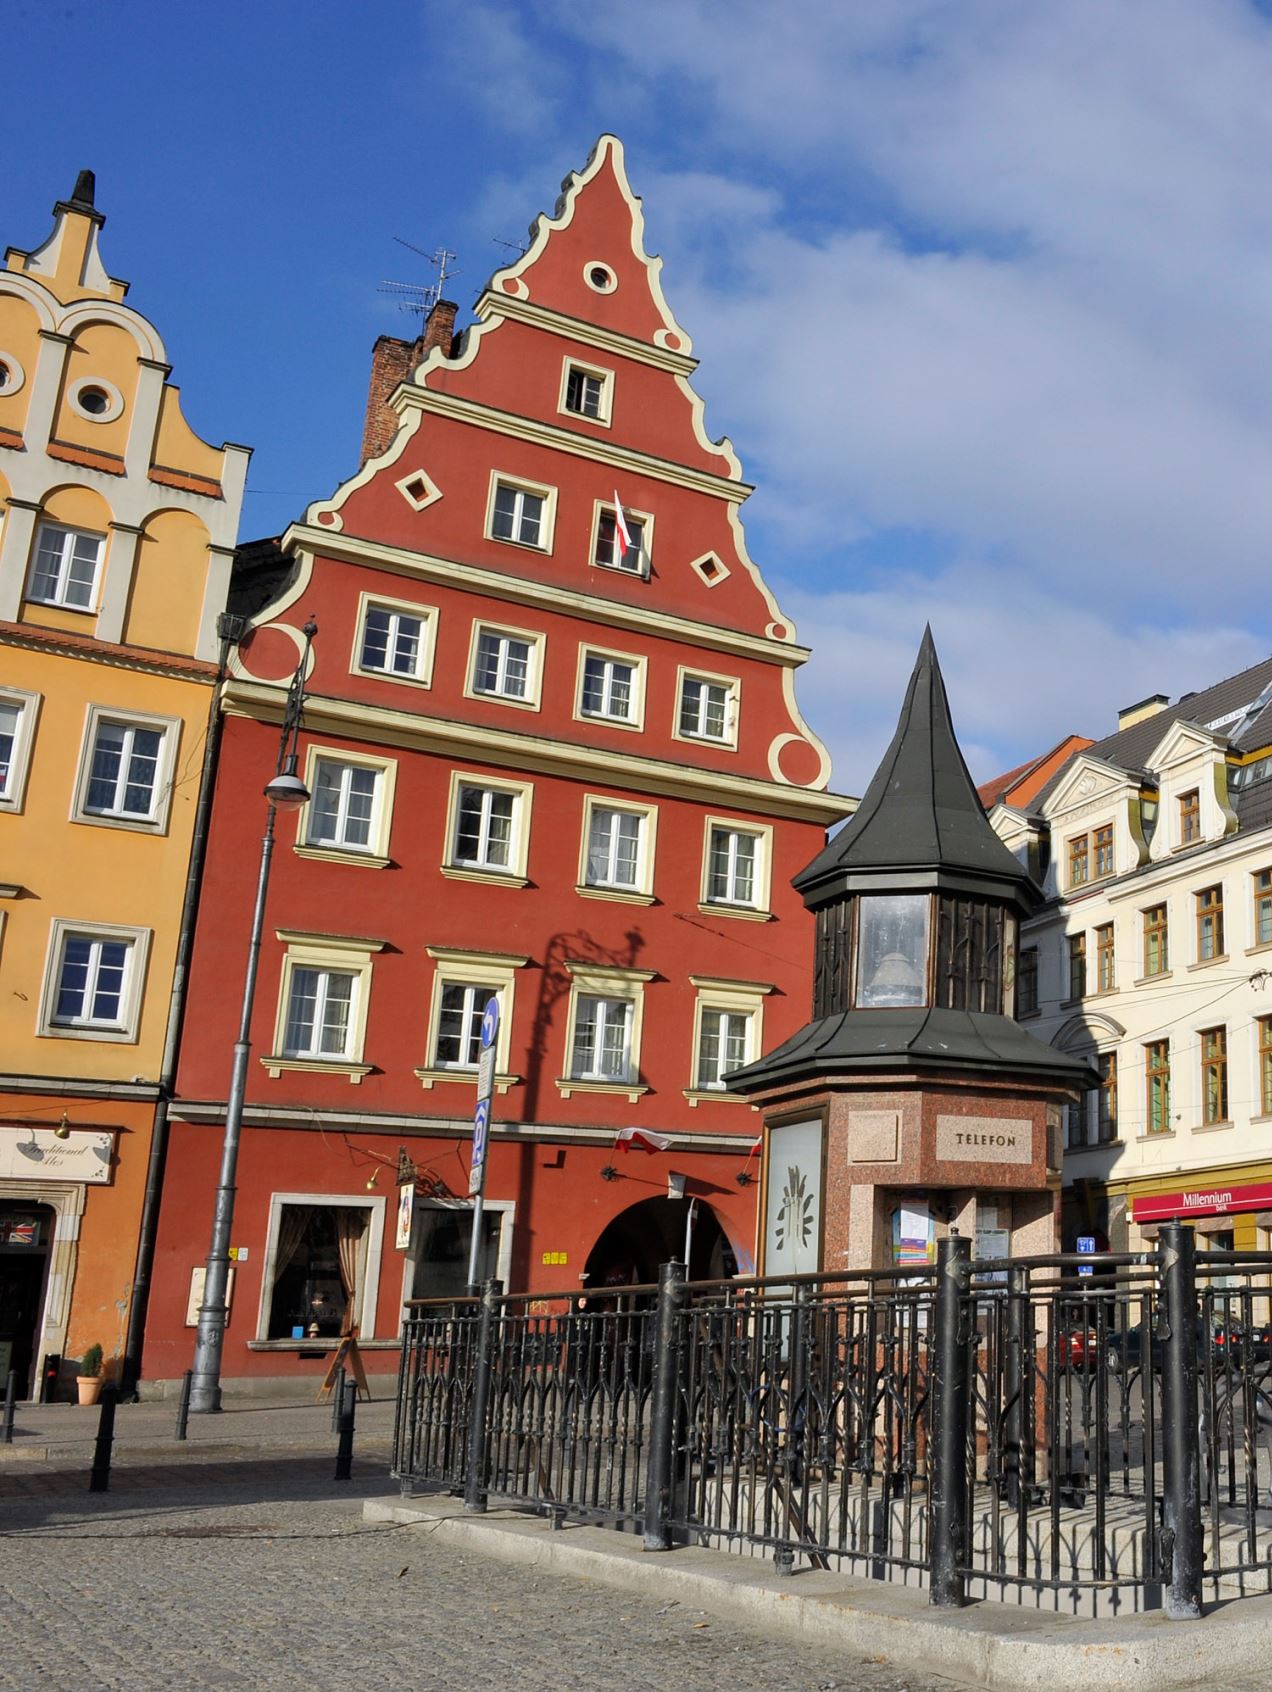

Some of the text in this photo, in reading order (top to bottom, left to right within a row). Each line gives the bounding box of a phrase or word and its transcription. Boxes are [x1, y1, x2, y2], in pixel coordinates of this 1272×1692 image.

[956, 1133, 1016, 1147] TELEFON
[1183, 1192, 1232, 1207] Millennium
[1216, 1204, 1228, 1212] bank
